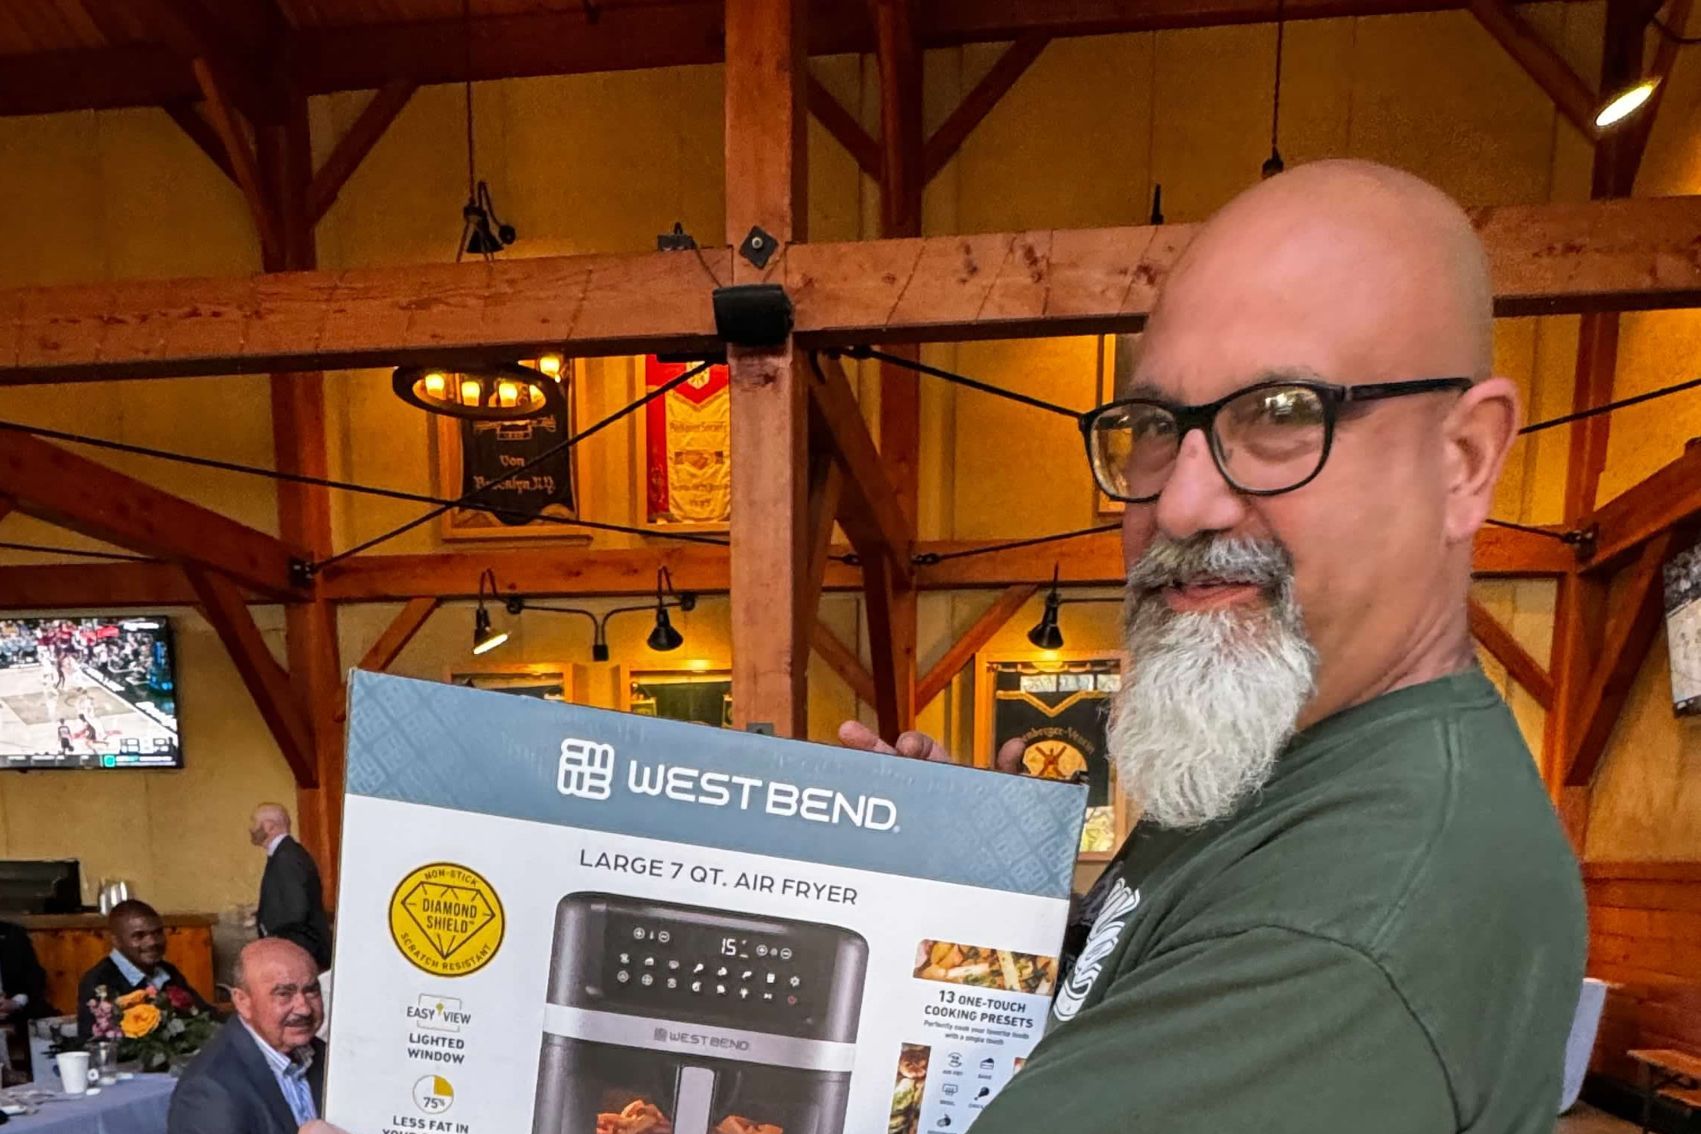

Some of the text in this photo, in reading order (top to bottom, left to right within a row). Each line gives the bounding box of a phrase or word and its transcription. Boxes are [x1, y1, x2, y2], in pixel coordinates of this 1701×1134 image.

[628, 760, 898, 831] WEST BEND
[424, 868, 478, 887] NON-STICK
[579, 849, 858, 905] LARGE 7 QT. AIR FRYER
[422, 898, 478, 919] DIAMOND
[400, 932, 491, 971] SCRATCH RESISTANT
[721, 937, 736, 956] 15
[938, 989, 1026, 1013] 13 ONE-TOUCH
[406, 1005, 472, 1025] EASY VIEW
[924, 1005, 1034, 1029] COOKING PRESETS
[408, 1032, 465, 1050] LIGHTED
[669, 1031, 750, 1051] WEST BEND
[407, 1048, 466, 1065] WINDOW
[423, 1096, 446, 1110] 75%
[392, 1115, 469, 1134] LESS FAT IN
